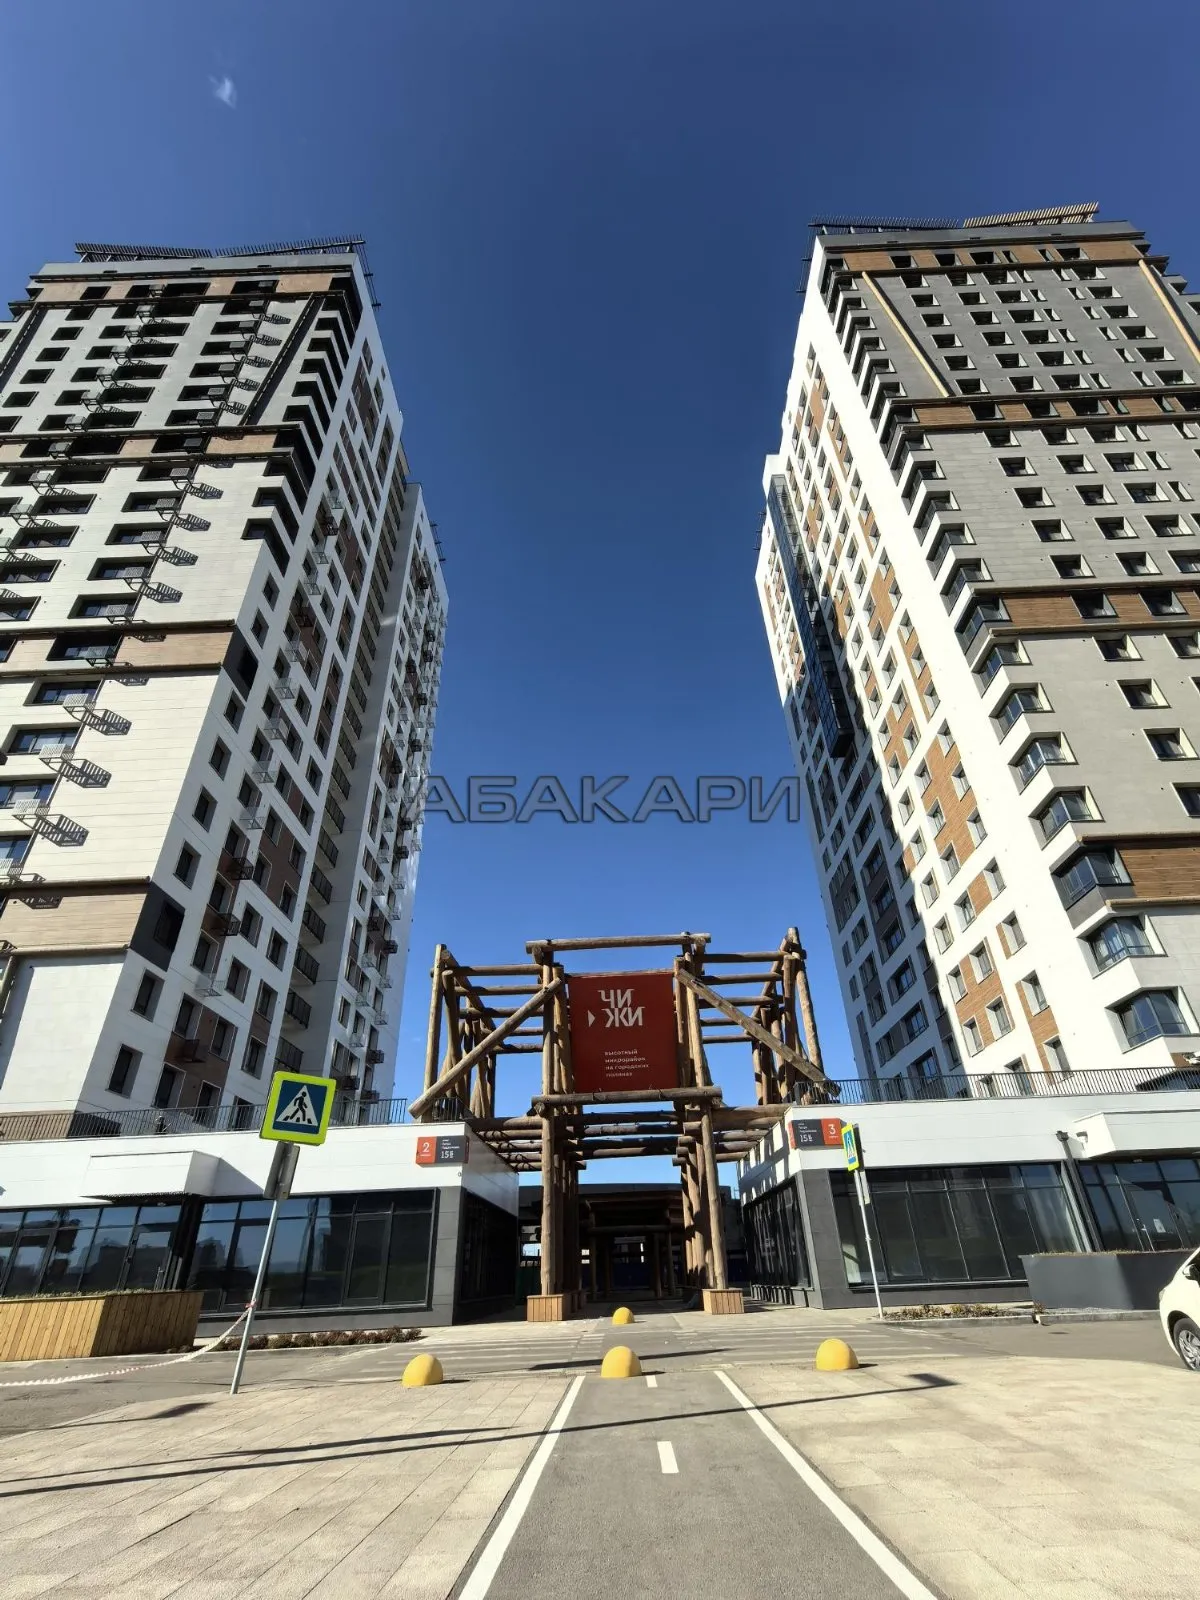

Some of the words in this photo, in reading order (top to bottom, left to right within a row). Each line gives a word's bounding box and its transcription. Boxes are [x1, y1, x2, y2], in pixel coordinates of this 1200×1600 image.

[597, 988, 635, 1008] ЧИ
[601, 1007, 646, 1027] ЖИ
[604, 1055, 646, 1063] микрорайон
[828, 1124, 836, 1134] 3
[422, 1142, 430, 1152] 2
